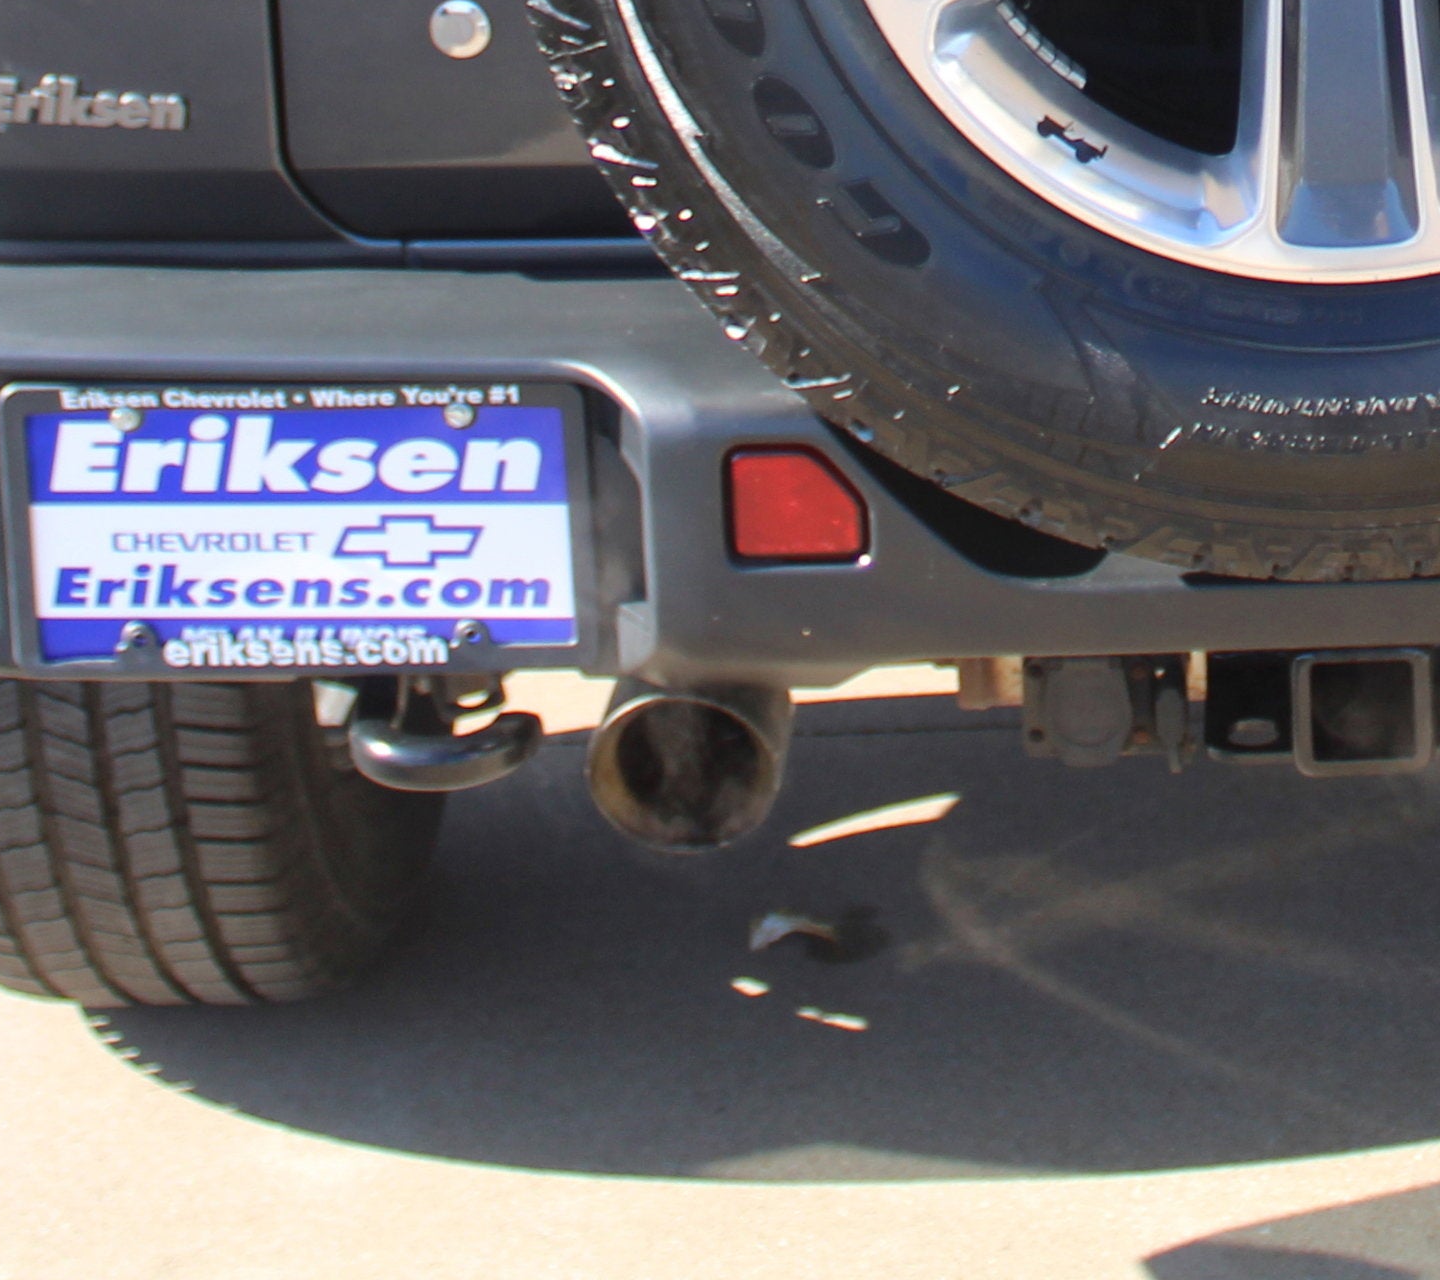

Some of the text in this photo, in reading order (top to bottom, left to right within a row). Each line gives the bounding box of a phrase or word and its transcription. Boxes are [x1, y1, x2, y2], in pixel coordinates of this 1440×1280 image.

[59, 384, 521, 410] Eriksen Chevrolet Where You're #1
[48, 415, 544, 493] Eriksen
[112, 531, 317, 553] CHEVROLET
[53, 563, 552, 608] Eriksens.com
[162, 629, 450, 668] eriksens.com
